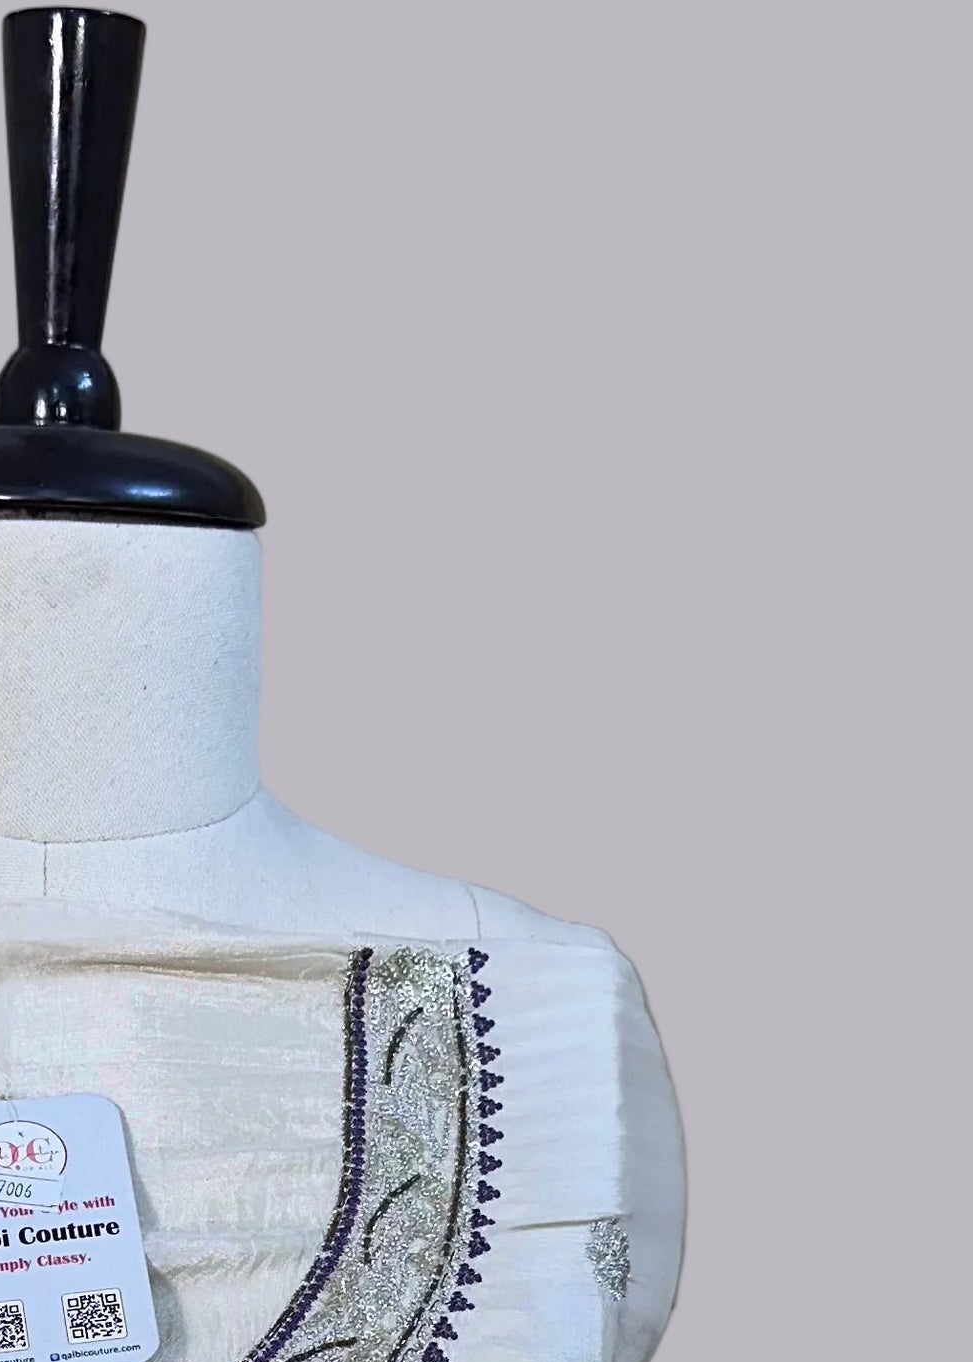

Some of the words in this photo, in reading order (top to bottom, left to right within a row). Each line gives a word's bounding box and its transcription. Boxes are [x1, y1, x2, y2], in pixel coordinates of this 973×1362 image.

[83, 1196, 115, 1209] with
[19, 1221, 120, 1245] Couture
[37, 1252, 92, 1267] Classy.
[61, 1344, 141, 1361] qalbicouture.com
